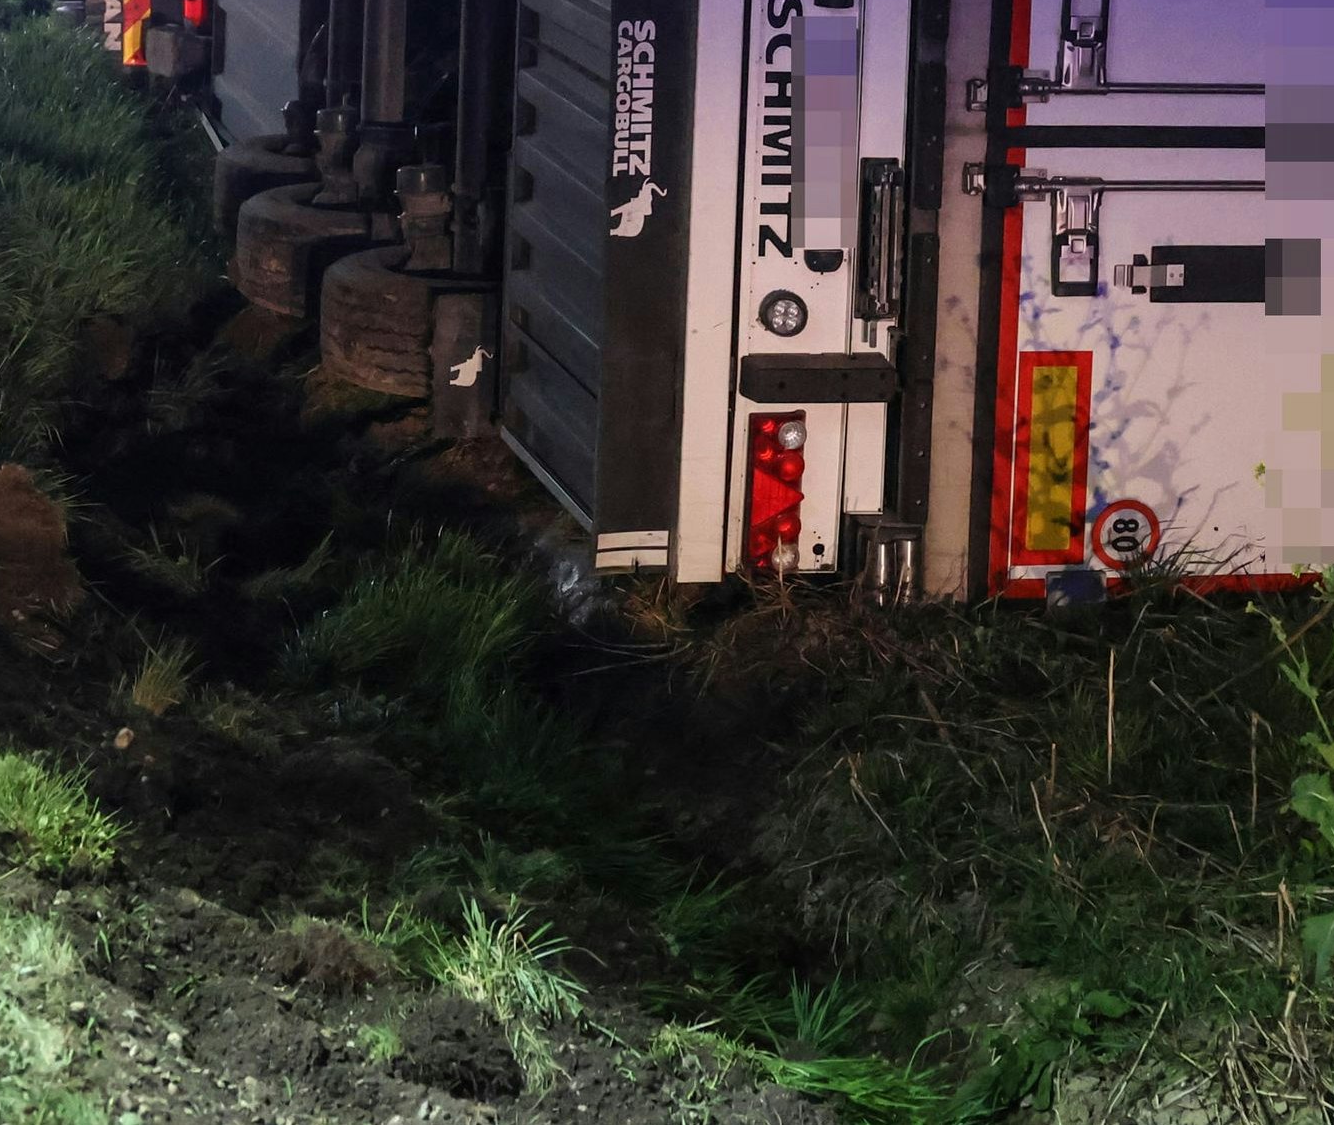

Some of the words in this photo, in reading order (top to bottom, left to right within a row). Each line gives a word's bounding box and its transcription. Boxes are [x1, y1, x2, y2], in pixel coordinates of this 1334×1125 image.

[612, 20, 634, 177] CARGOBULL
[629, 19, 656, 176] SCHMITZ
[1112, 518, 1140, 552] 80
